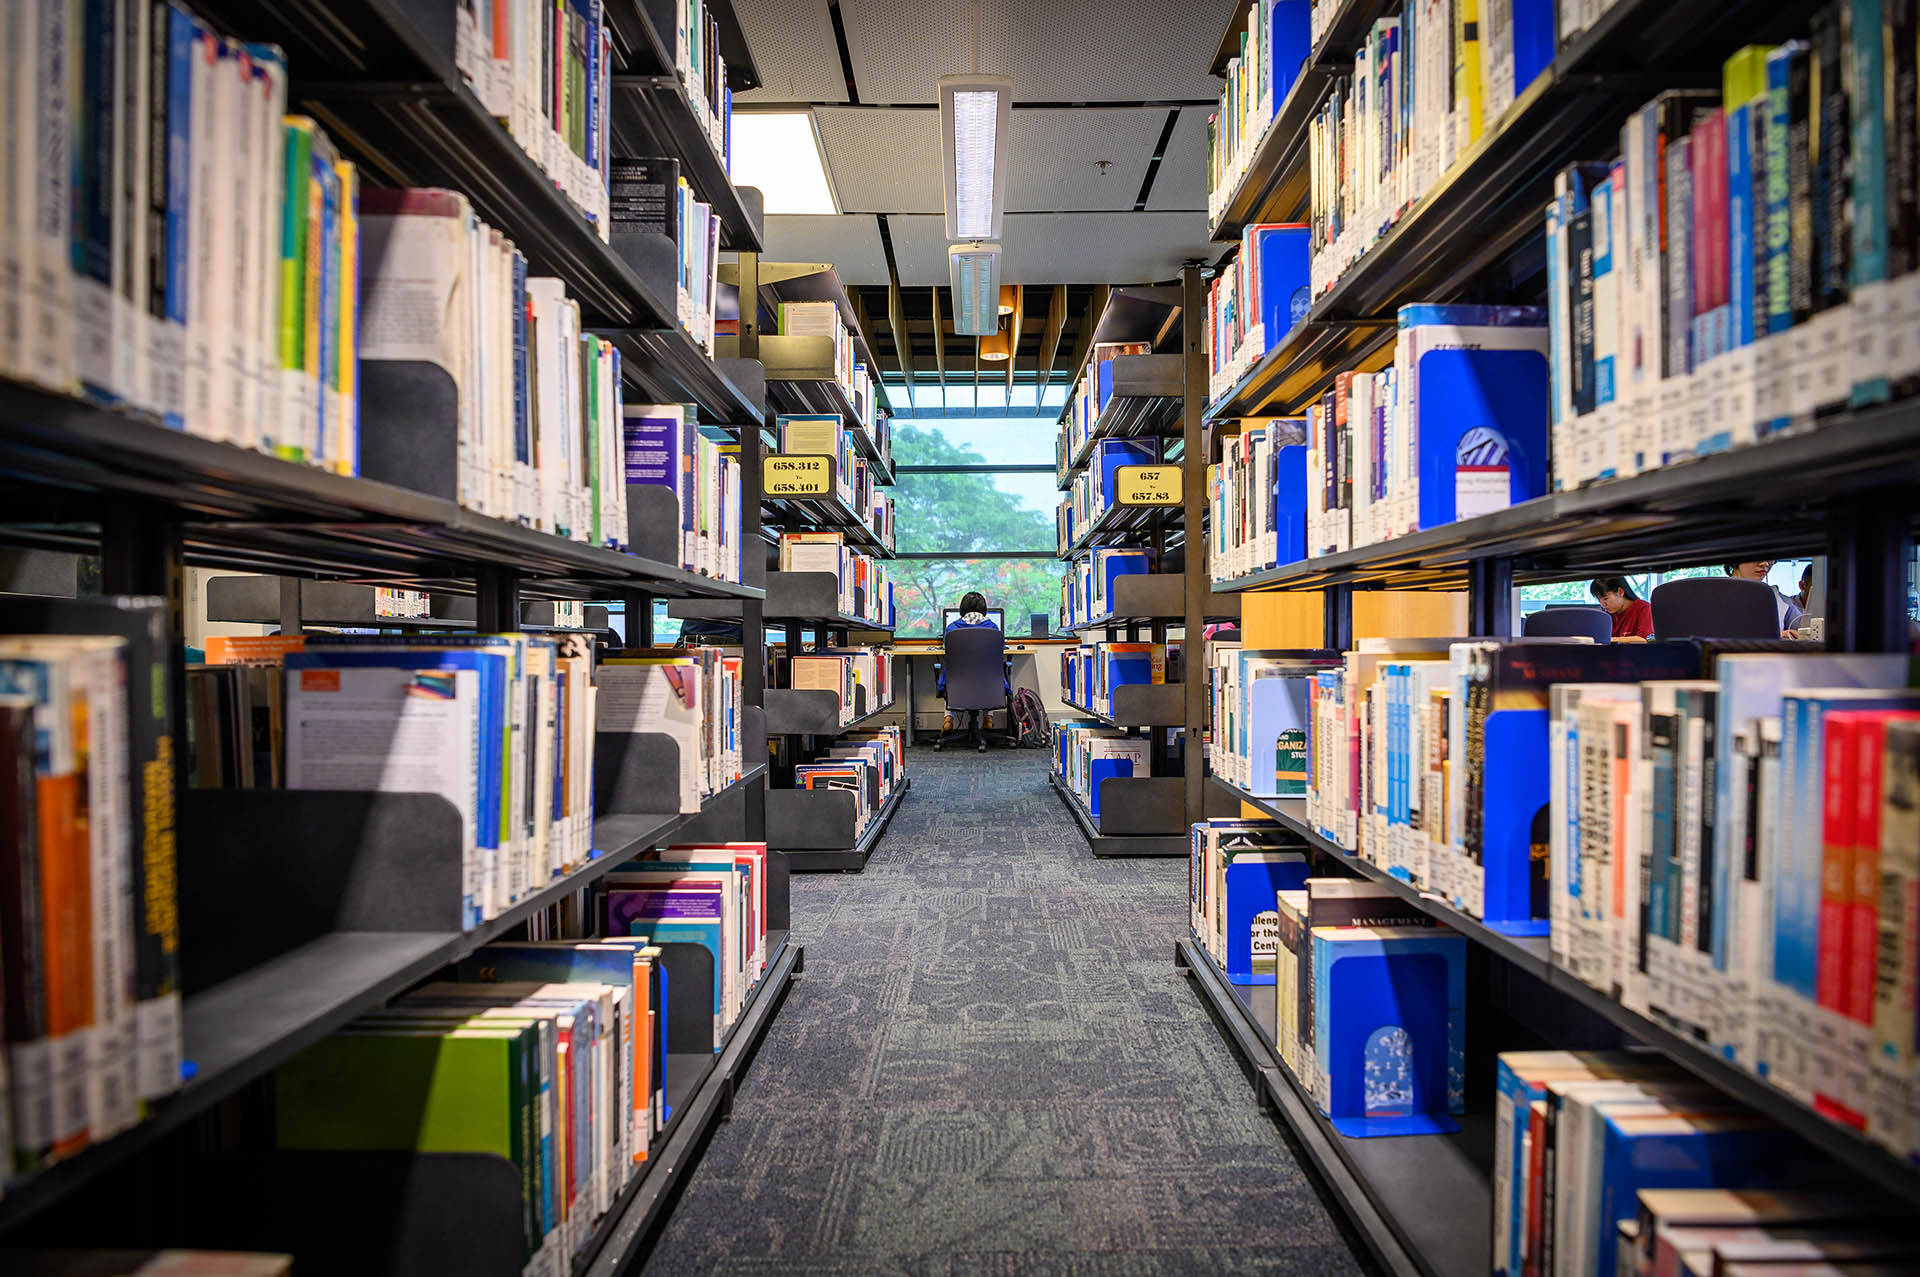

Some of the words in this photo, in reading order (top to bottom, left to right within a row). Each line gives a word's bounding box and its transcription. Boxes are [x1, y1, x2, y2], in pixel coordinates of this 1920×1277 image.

[773, 462, 820, 470] 658.312
[1139, 472, 1160, 481] 657
[773, 483, 819, 492] 658.401
[1131, 491, 1169, 501] 657.83
[1263, 929, 1279, 937] the
